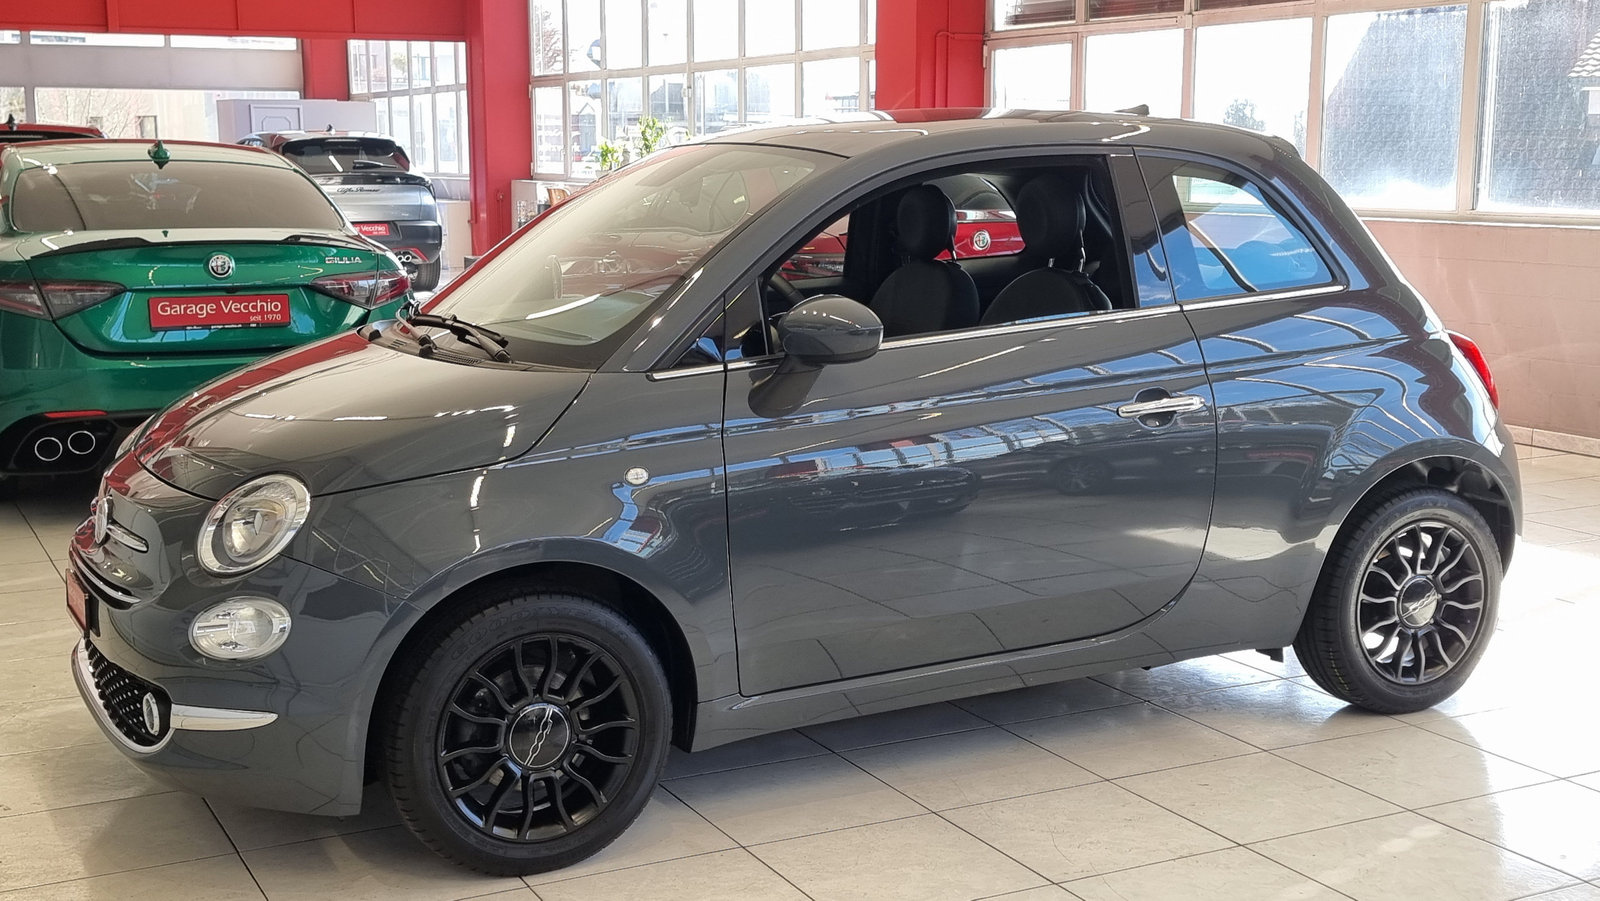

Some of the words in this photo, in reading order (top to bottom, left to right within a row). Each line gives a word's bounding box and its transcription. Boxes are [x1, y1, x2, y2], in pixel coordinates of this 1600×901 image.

[325, 256, 362, 264] GIULIA
[157, 301, 216, 318] Garage
[220, 299, 282, 313] Vecchio
[249, 314, 262, 322] seit
[264, 313, 282, 321] 1970
